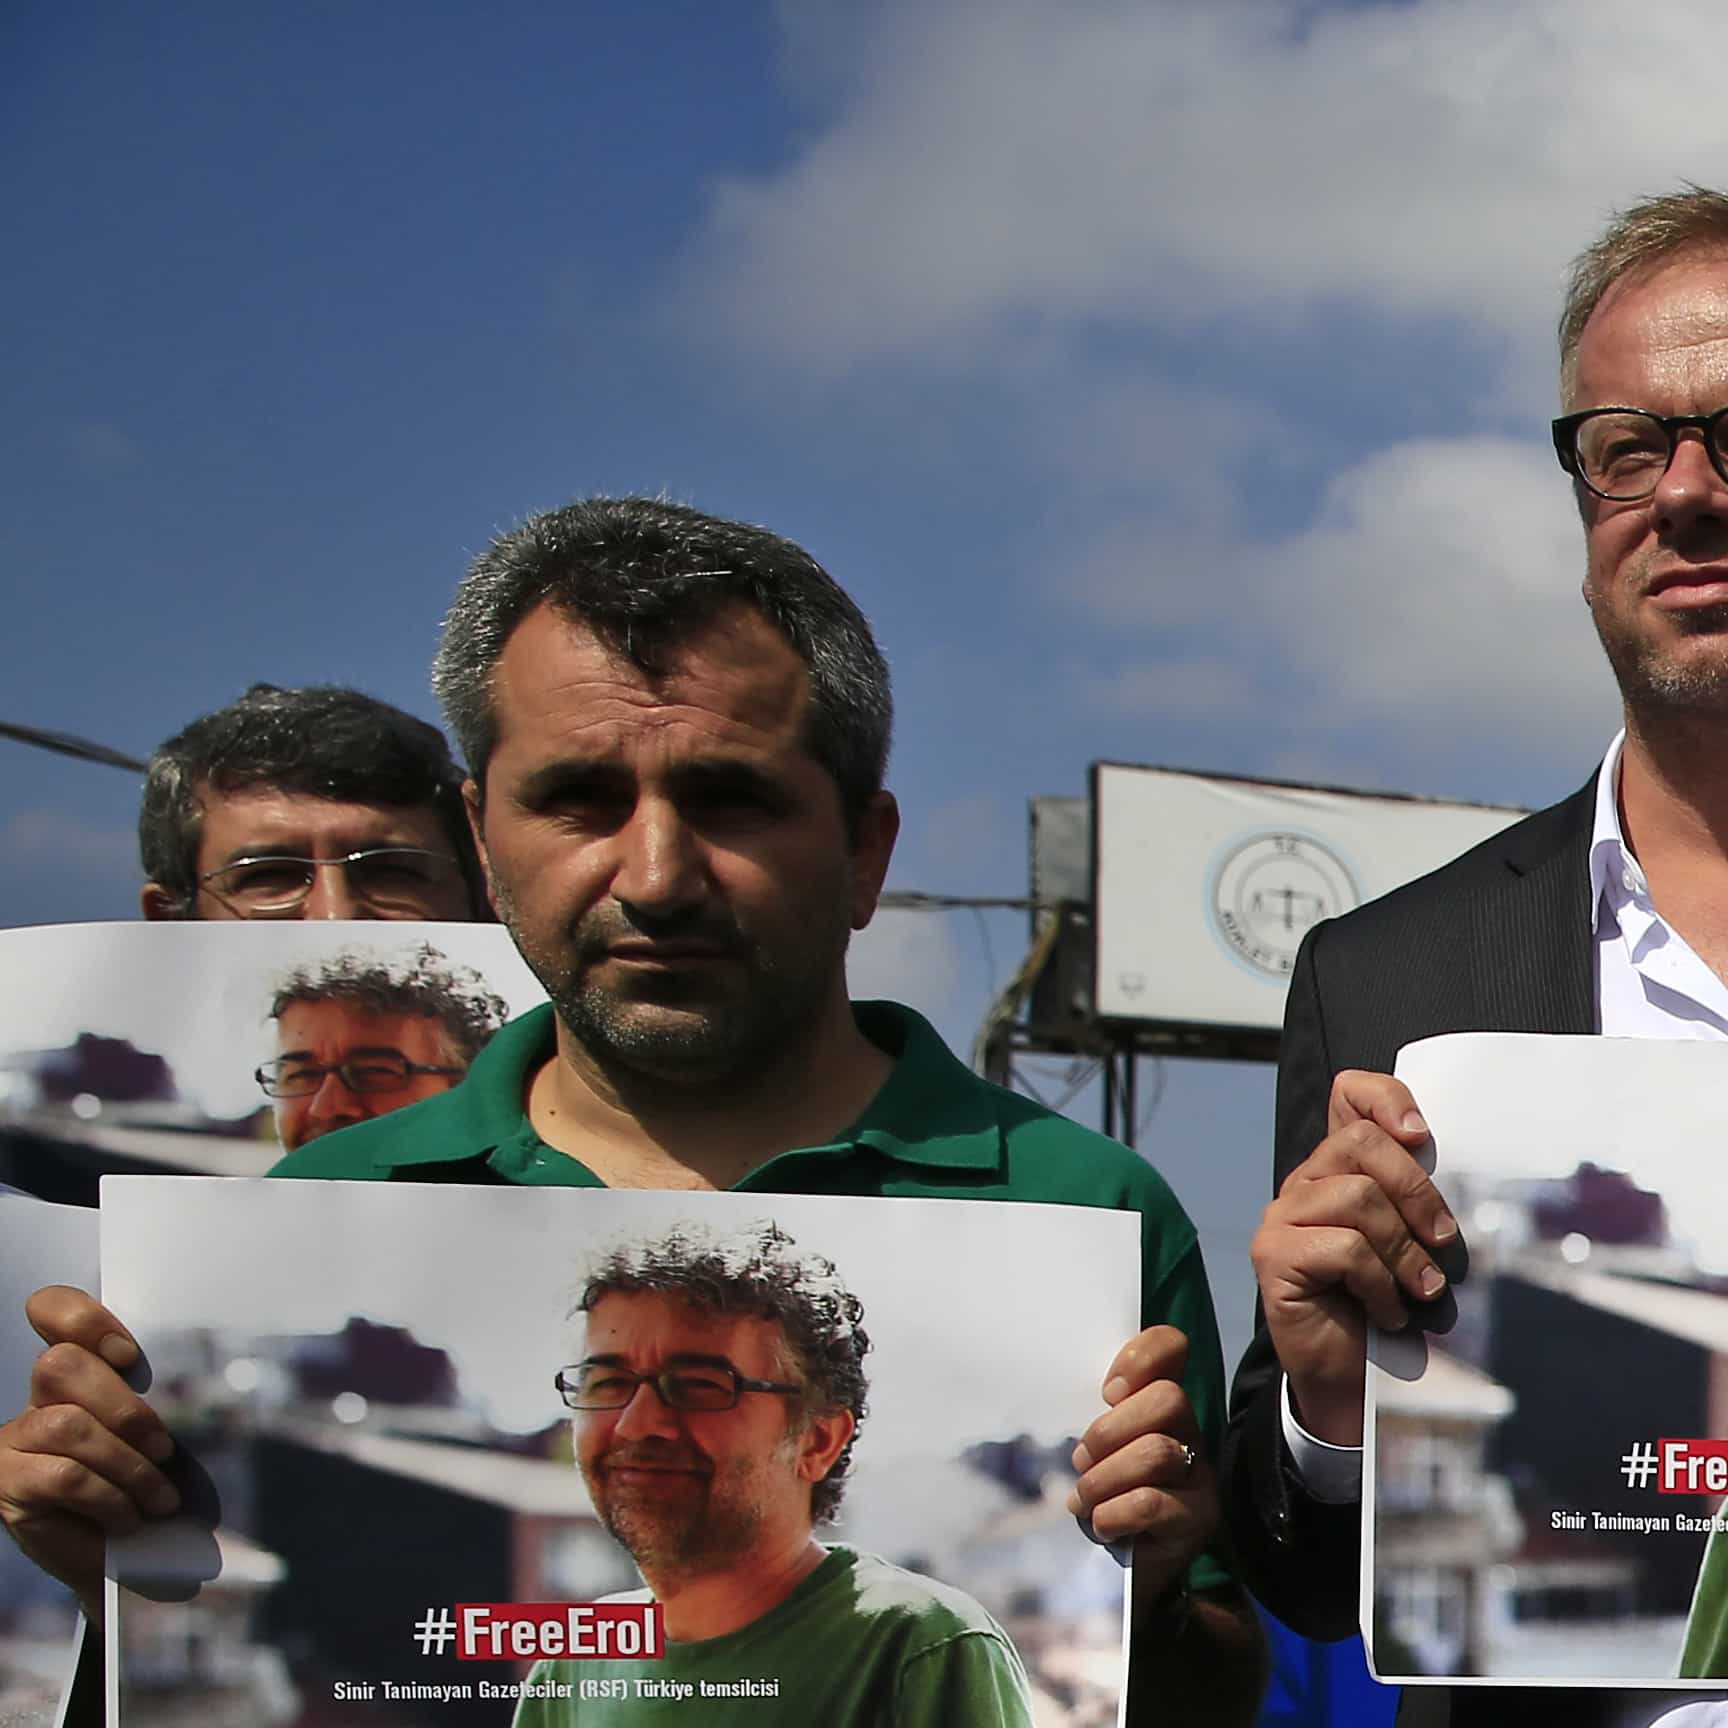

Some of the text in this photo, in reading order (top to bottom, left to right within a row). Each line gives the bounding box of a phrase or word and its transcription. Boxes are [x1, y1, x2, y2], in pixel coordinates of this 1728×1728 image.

[1551, 1511, 1587, 1531] Sinir
[1592, 1512, 1670, 1534] Tanimayan
[413, 1607, 656, 1655] #FreeErol
[333, 1678, 780, 1703] Sinir Tanimayan Gazeteciler (RSF) Türkiye temsilcisi
